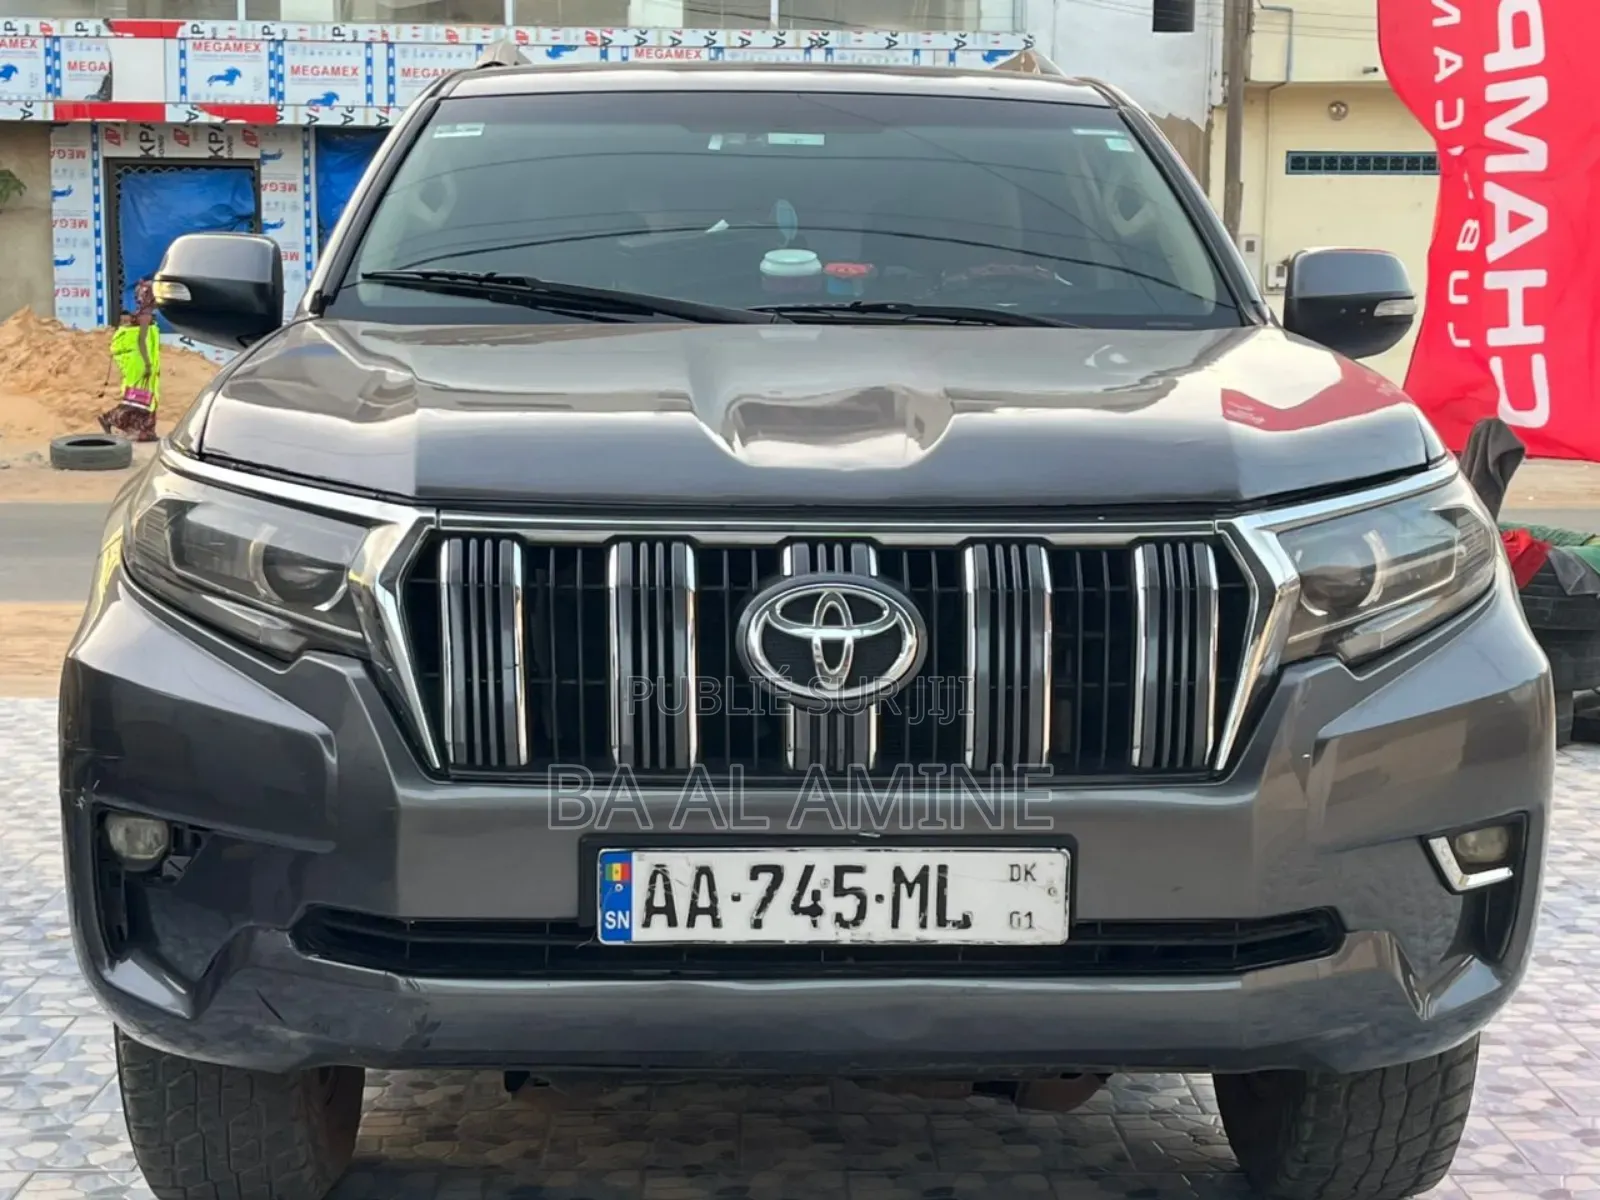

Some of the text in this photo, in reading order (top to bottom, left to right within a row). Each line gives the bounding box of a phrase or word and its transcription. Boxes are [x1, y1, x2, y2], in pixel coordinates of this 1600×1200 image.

[192, 41, 261, 53] MEGAMEX
[634, 48, 701, 59] MEGAMEX
[290, 65, 359, 77] MEGAMEX
[1008, 862, 1037, 882] DK
[604, 910, 630, 930] SN
